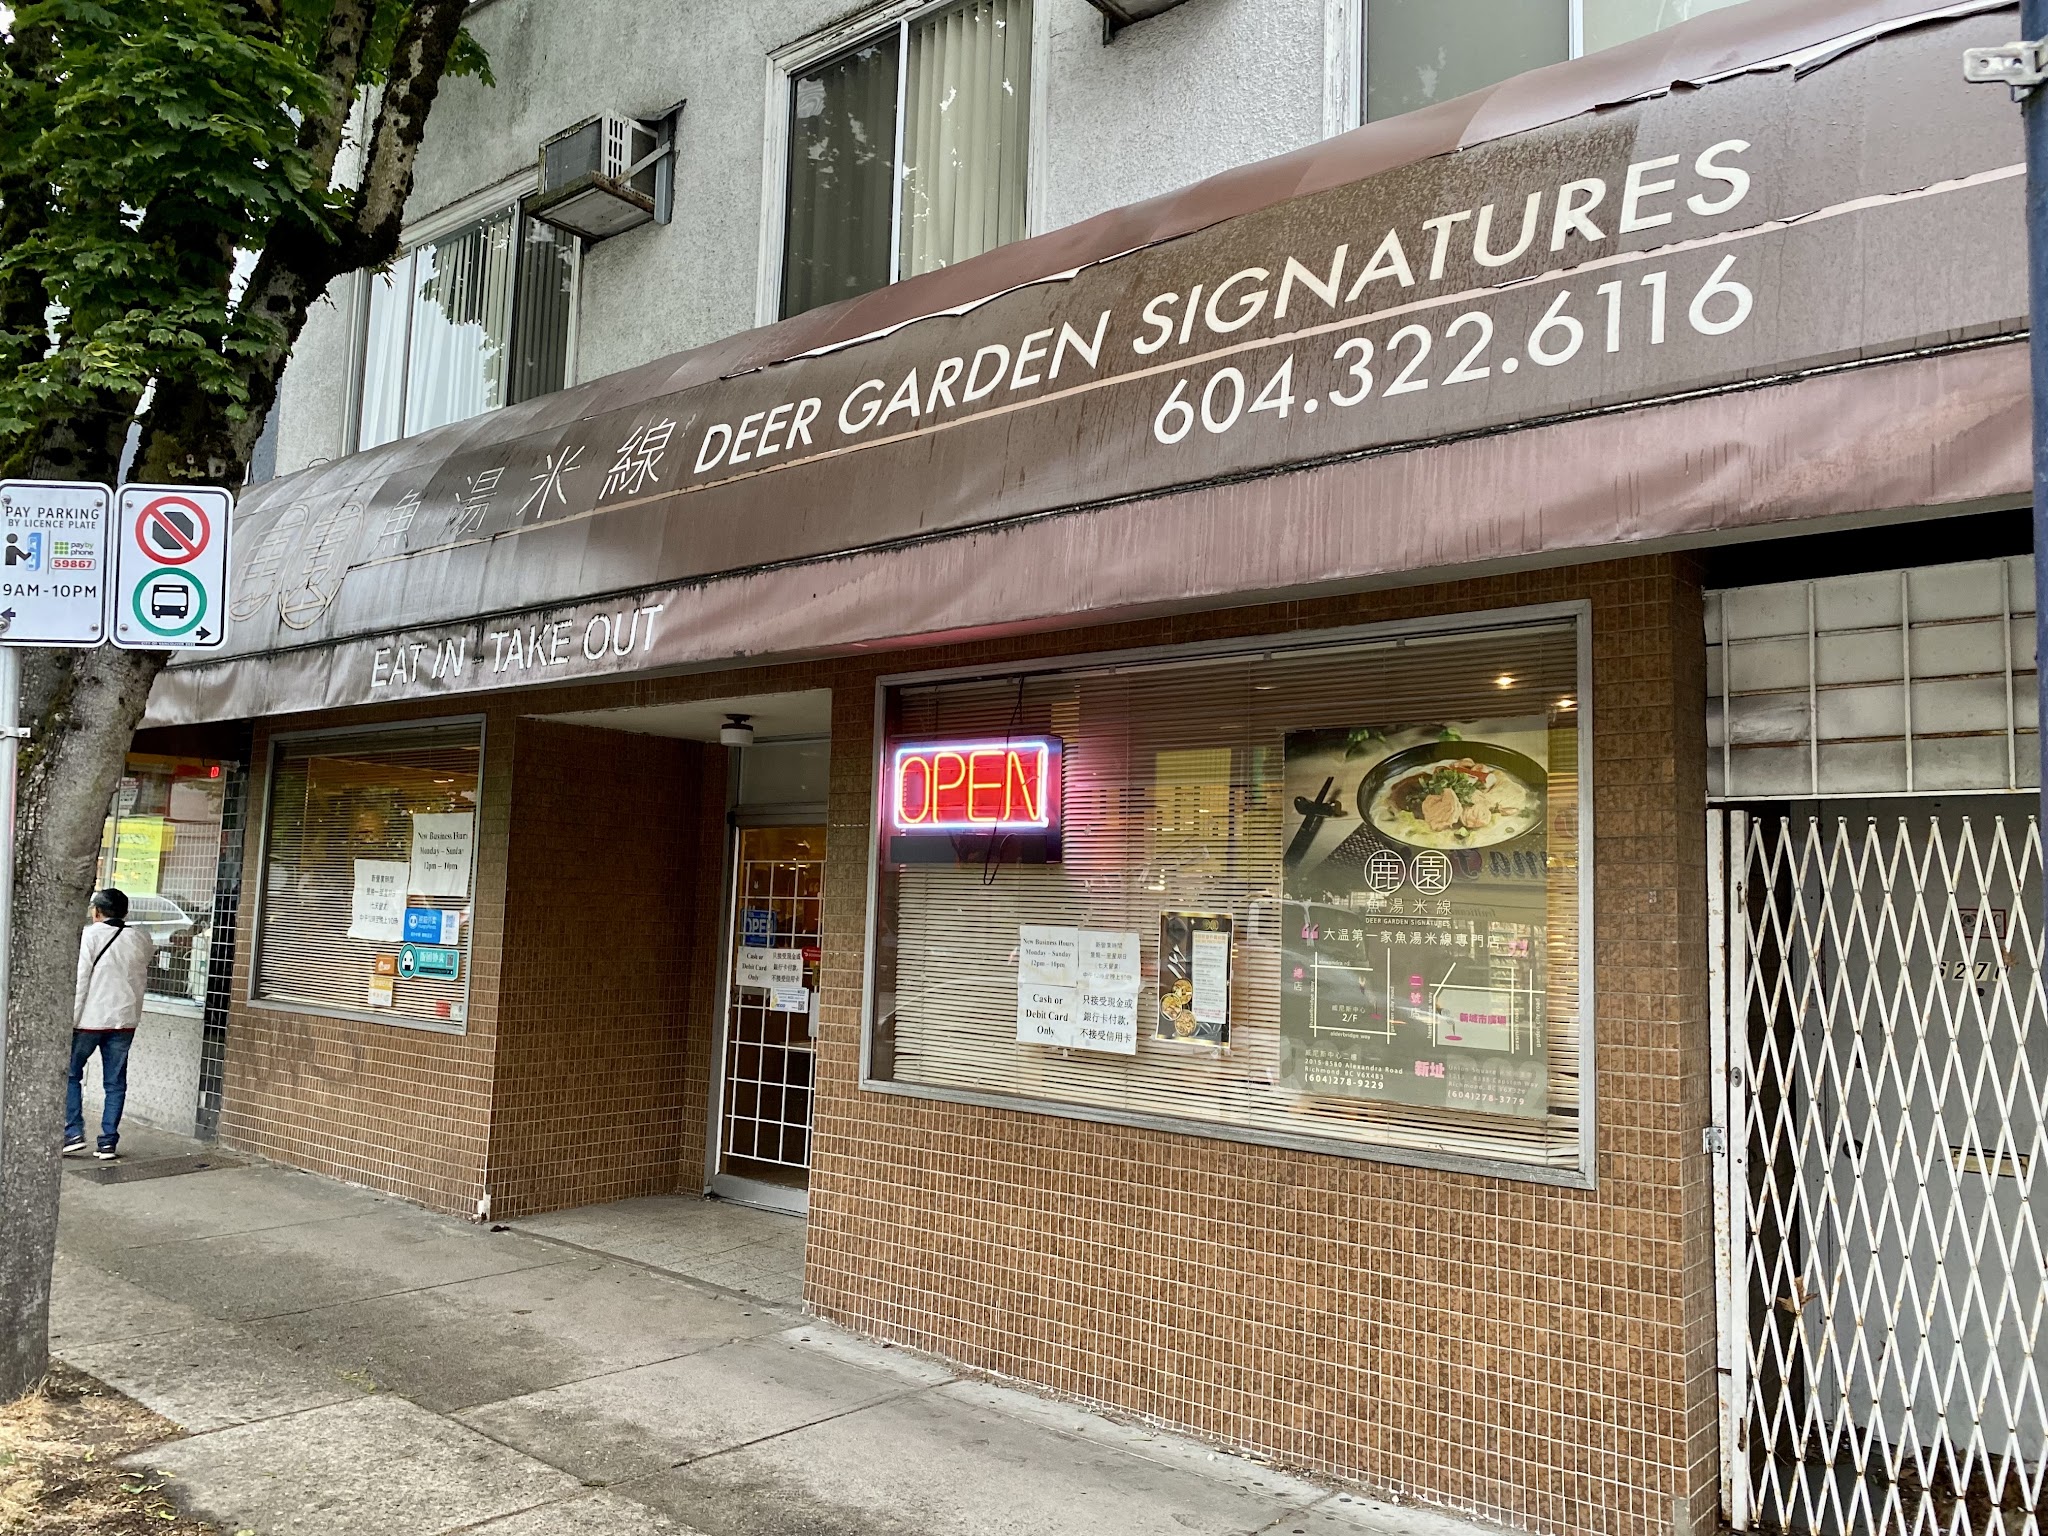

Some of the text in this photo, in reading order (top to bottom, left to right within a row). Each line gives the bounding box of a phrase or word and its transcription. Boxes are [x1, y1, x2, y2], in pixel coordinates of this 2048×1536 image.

[694, 139, 1751, 474] DEER GARDEN SIGNATURES
[1154, 254, 1753, 445] 604.322.6116
[6, 506, 100, 520] PAY PARKING
[8, 519, 96, 530] BY LICENCE PLATE
[70, 549, 94, 557] phone
[54, 560, 92, 569] 59867
[371, 642, 428, 689] EAT
[431, 637, 467, 680] IN
[491, 619, 574, 673] TAKE
[583, 604, 664, 660] OUT
[899, 748, 1045, 824] OPEN
[418, 831, 469, 840] New Business Hours
[420, 846, 440, 856] Monday
[445, 846, 464, 856] Sunda
[1365, 849, 1453, 896] 鹿園
[1366, 897, 1452, 916] 魚湯米線
[1410, 919, 1451, 928] SIGNATURES
[747, 952, 759, 960] Cash
[1026, 949, 1046, 958] Monday
[1052, 951, 1071, 960] Sunday
[755, 964, 767, 972] Card
[747, 973, 759, 982] Only
[1032, 993, 1064, 1005] Cash or
[1082, 994, 1133, 1010] 只接受現金或
[1025, 1008, 1069, 1022] Debit Card
[1342, 1013, 1358, 1023] 2/F
[1037, 1025, 1055, 1037] Only
[1080, 1028, 1132, 1043] 不接受信用卡
[1345, 1062, 1382, 1072] Alexandra
[1384, 1066, 1403, 1075] Road
[1414, 1060, 1445, 1079] 新址
[1304, 1073, 1384, 1090] (604)278-9229
[1447, 1090, 1525, 1106] (604)278-3779
